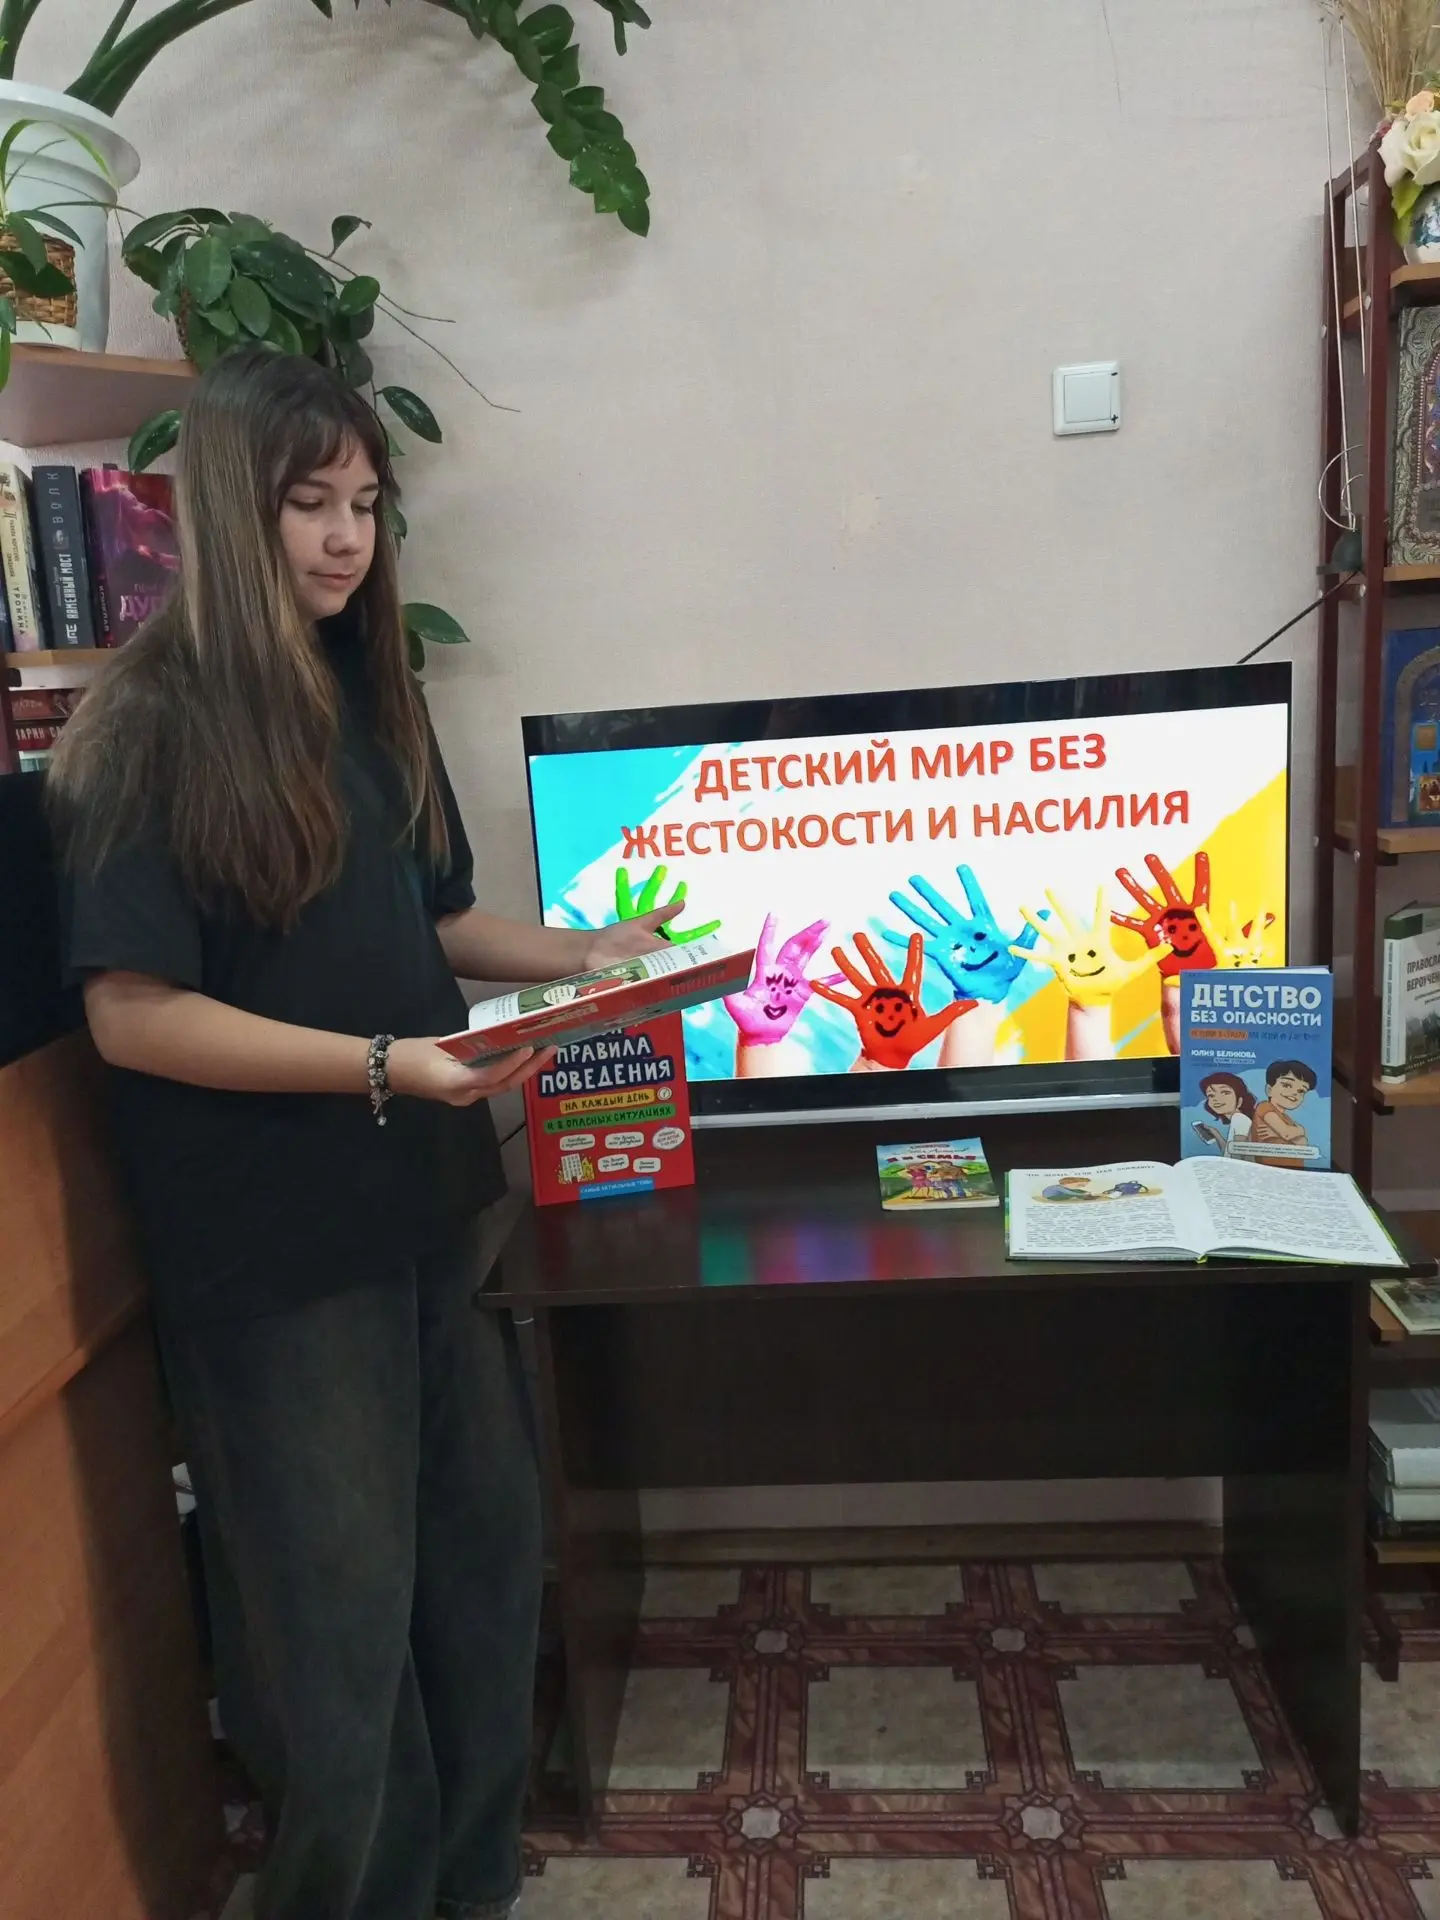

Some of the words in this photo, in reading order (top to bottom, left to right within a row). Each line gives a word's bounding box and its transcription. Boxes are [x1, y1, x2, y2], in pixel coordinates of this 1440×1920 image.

[60, 553, 72, 575] МОСТ
[13, 585, 25, 636] ТРОНИНА
[694, 739, 896, 802] ДЕТСКИЙ
[911, 740, 1014, 779] МИР
[1029, 732, 1107, 771] БЕЗ
[619, 809, 914, 860] ЖЕСТОКОСТИ
[928, 805, 957, 838] И
[973, 790, 1191, 837] НАСИЛИЯ
[1191, 983, 1322, 1010] ДЕТСТВО
[1190, 1010, 1217, 1024] БЕЗ
[1223, 1011, 1322, 1027] ОПАСНОСТИ
[556, 1036, 651, 1064] ПРАВИЛА
[1191, 1049, 1215, 1057] ЮЛИЯ
[1216, 1051, 1257, 1059] БЕЛИКОВА
[541, 1060, 671, 1094] ПОВЕДЕНИЯ
[564, 1101, 578, 1111] НА
[581, 1095, 624, 1109] КАЖДЫЙ
[626, 1092, 650, 1104] ДЕНЬ
[566, 1114, 613, 1130] ОПАСНЫХ
[613, 1105, 672, 1123] СИТУАЦИЯХ
